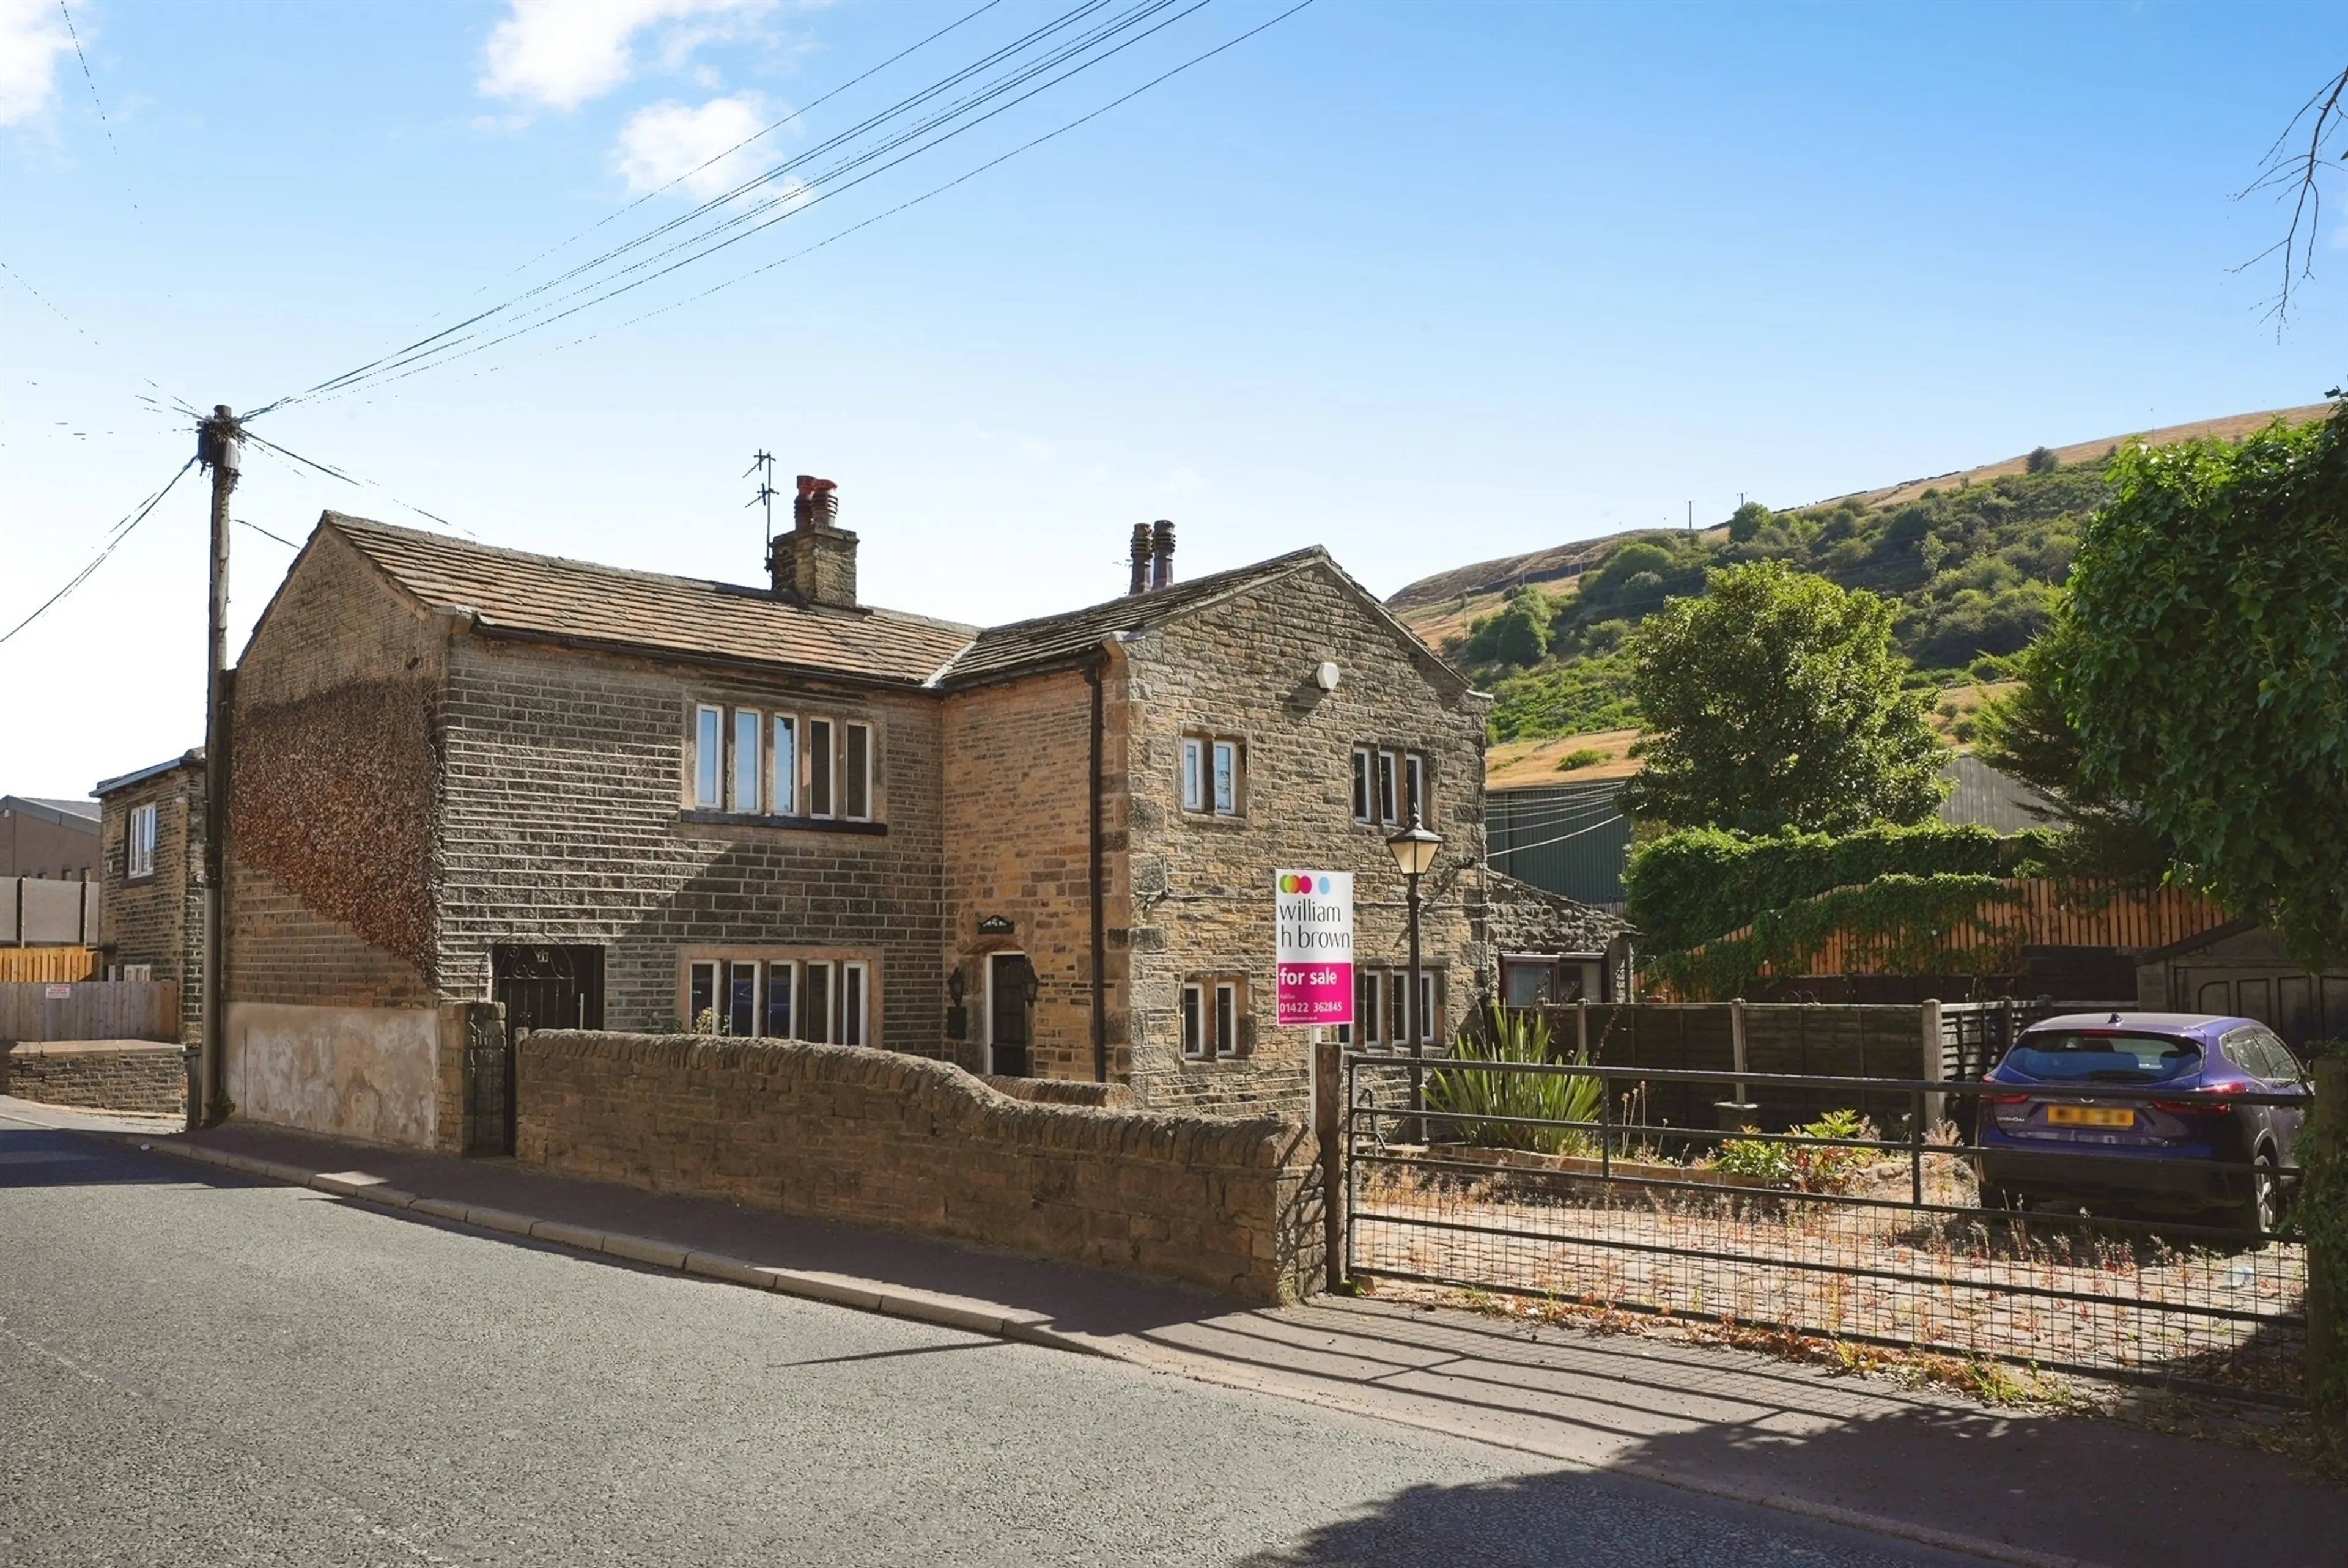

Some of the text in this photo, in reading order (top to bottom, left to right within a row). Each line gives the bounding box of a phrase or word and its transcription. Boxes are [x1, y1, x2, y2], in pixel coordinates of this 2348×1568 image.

[1279, 898, 1341, 922] william
[1282, 924, 1351, 948] h brown
[1280, 966, 1337, 985] for sale
[1279, 1003, 1309, 1013] 01422
